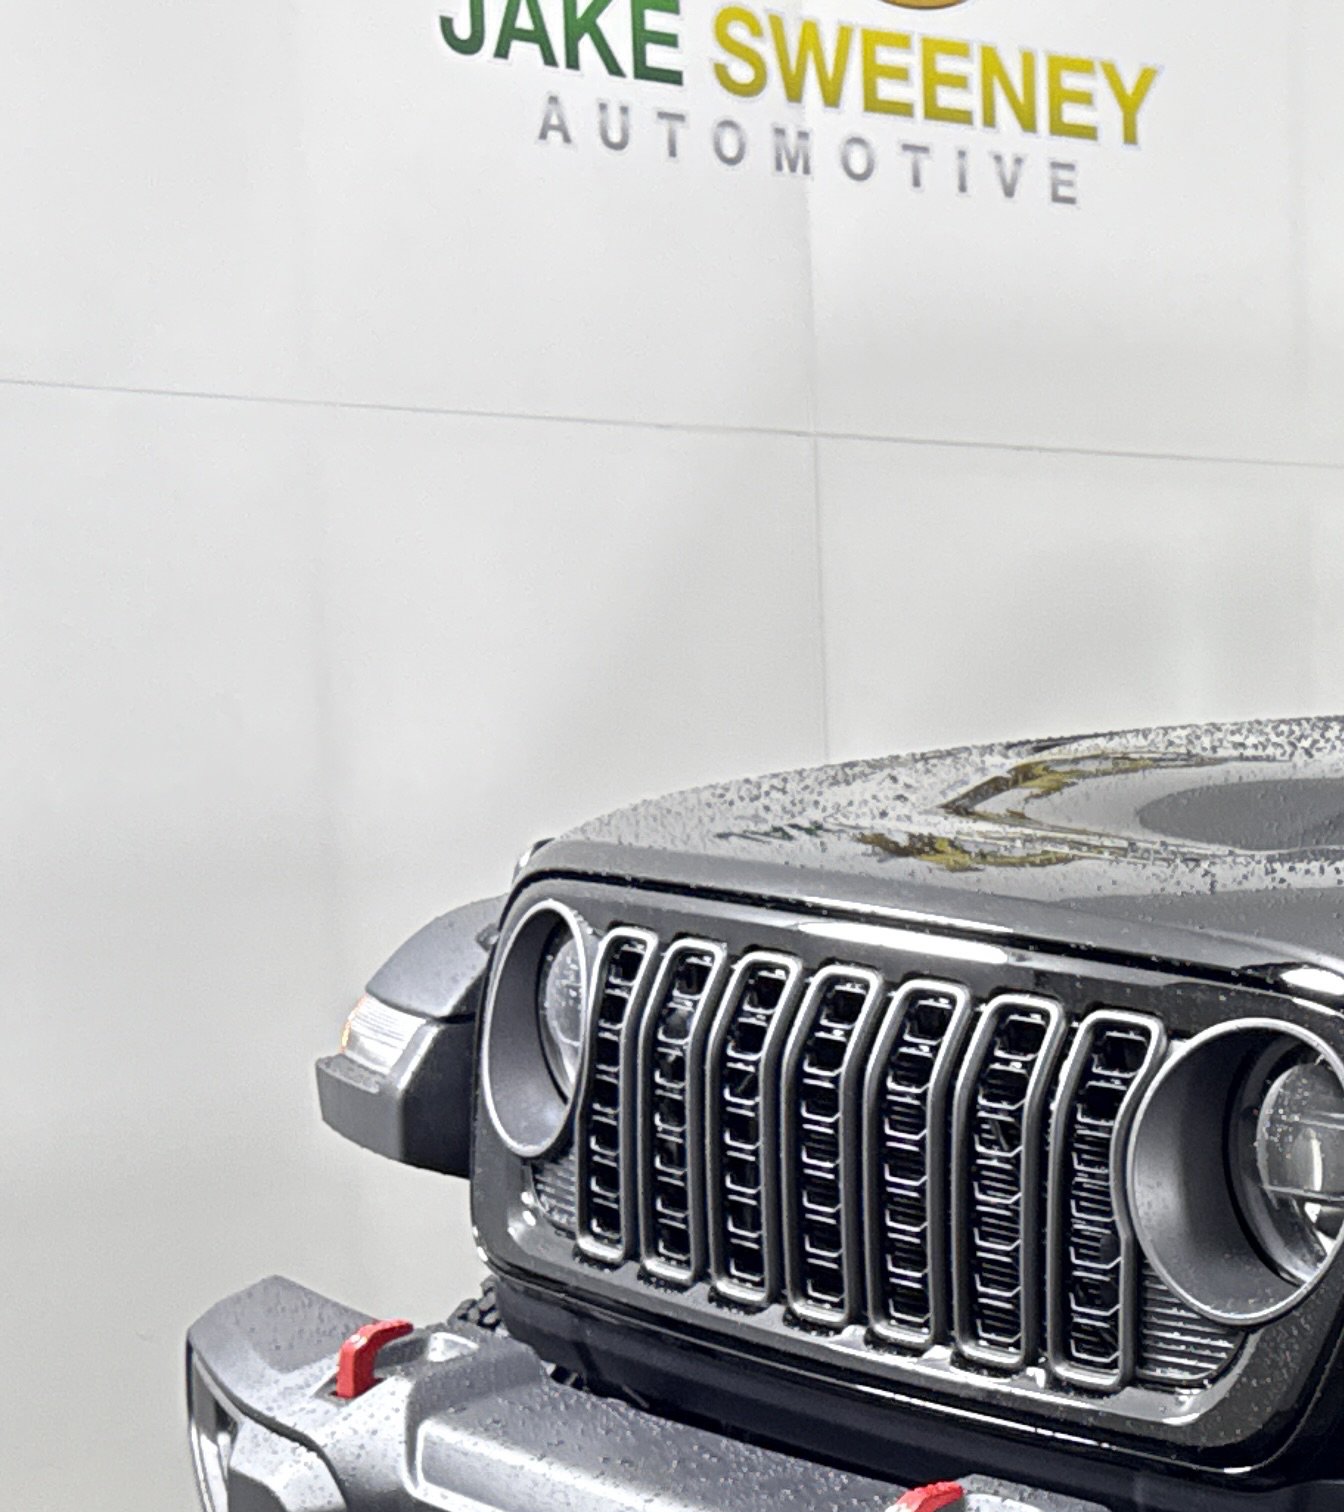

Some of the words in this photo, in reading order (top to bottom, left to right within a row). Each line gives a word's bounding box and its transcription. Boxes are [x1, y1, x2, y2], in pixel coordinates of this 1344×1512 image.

[439, 0, 684, 87] JAKE
[712, 5, 1159, 145] SWEENEY
[537, 95, 1078, 205] AUTOMOTIVE
